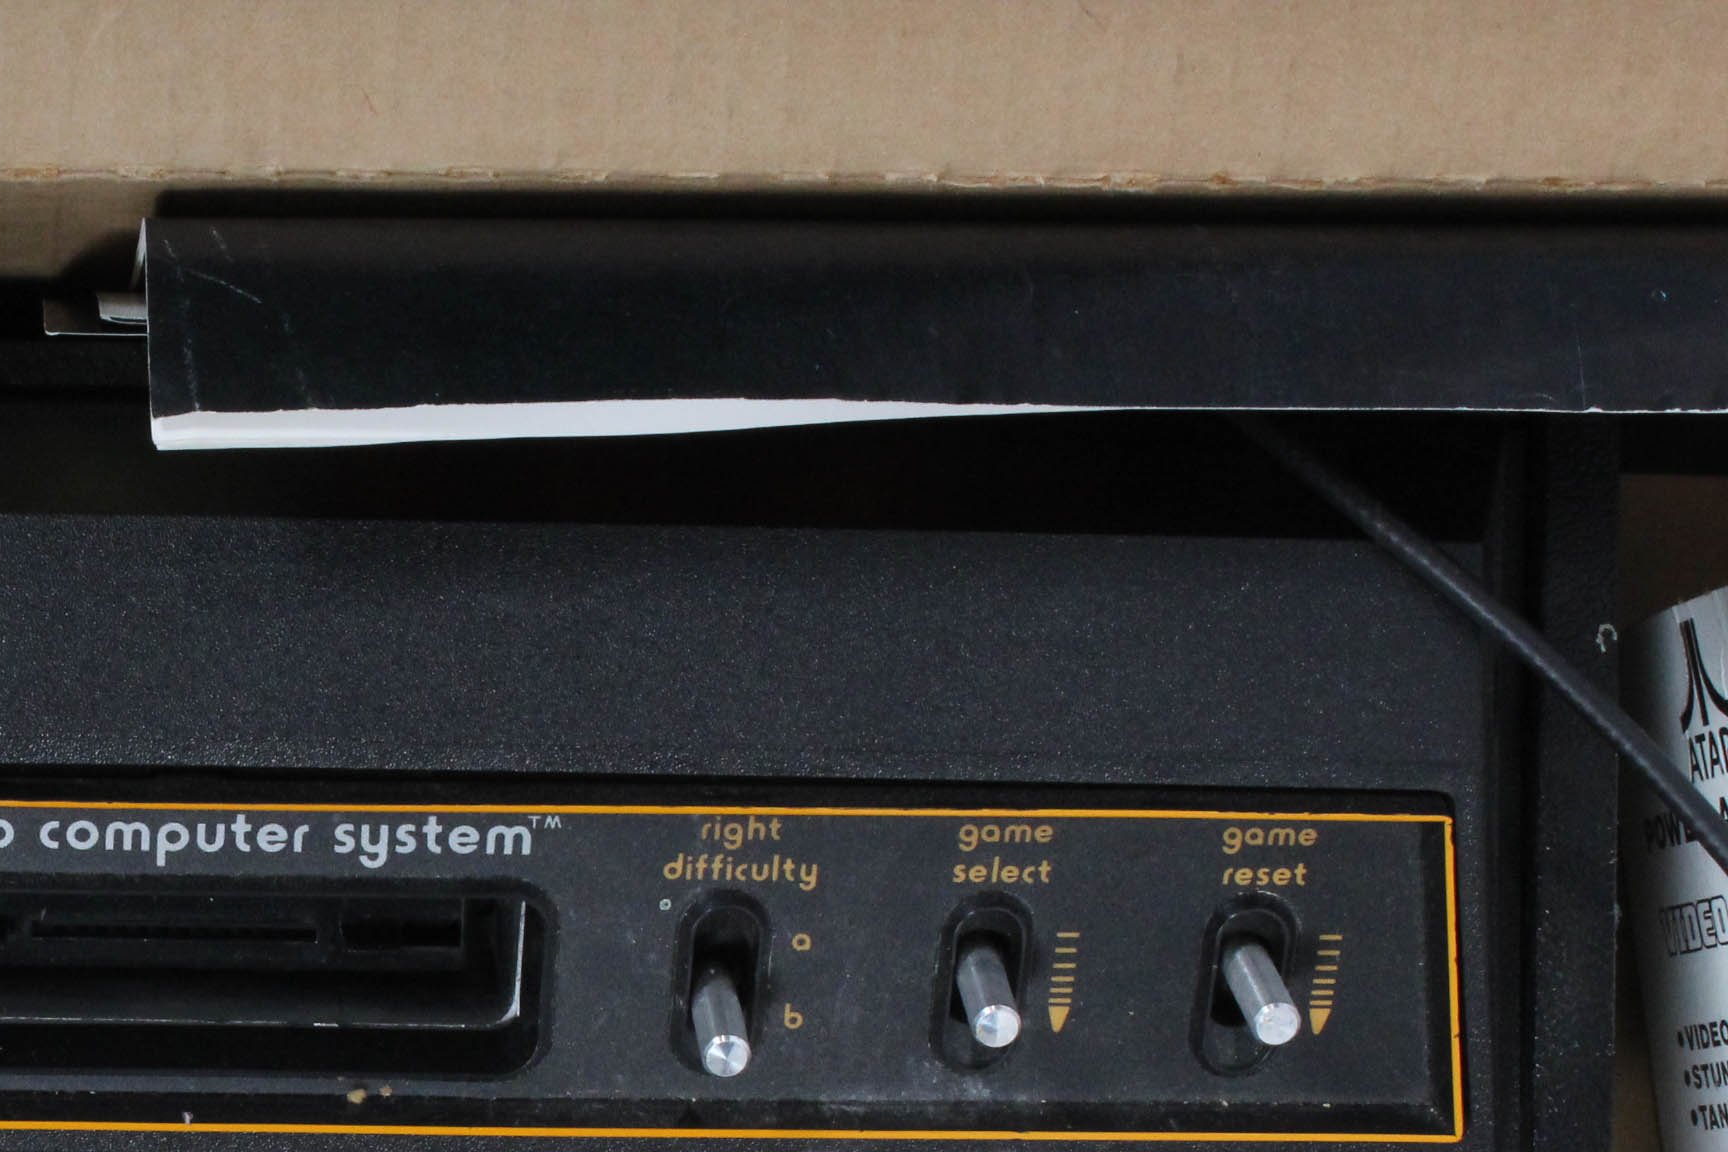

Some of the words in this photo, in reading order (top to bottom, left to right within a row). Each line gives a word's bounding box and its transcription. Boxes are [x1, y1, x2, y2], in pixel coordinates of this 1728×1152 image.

[40, 814, 310, 867] computer
[700, 815, 782, 850] right
[958, 823, 1055, 851] game
[1222, 826, 1318, 854] game
[1640, 812, 1698, 853] POWE
[663, 853, 819, 891] difficulty
[952, 857, 1052, 884] select
[1222, 863, 1307, 886] reset
[1660, 895, 1728, 958] VIDEO
[792, 933, 812, 951] a
[784, 1003, 804, 1029] b
